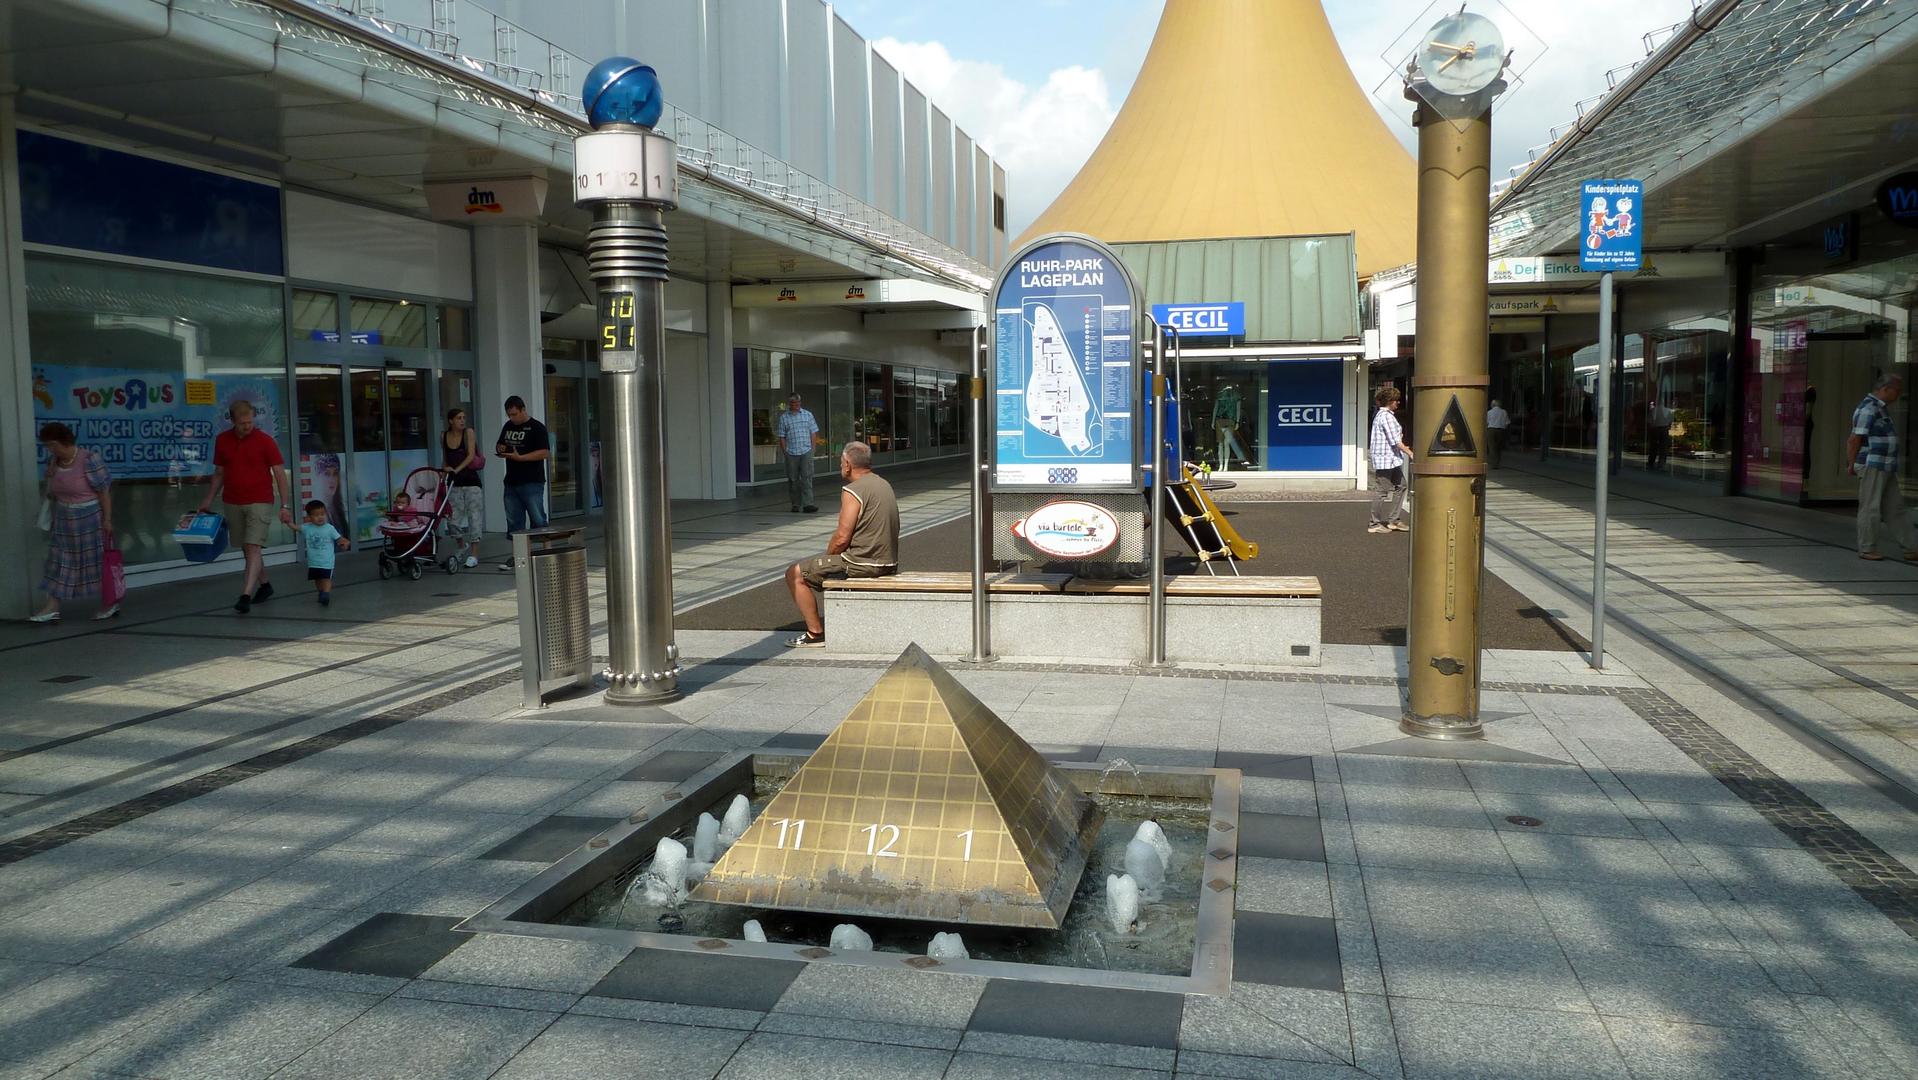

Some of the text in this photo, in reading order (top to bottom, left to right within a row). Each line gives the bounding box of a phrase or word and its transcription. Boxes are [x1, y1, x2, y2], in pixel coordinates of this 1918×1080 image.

[578, 174, 588, 188] 10
[468, 187, 495, 204] dm
[1585, 184, 1639, 195] Kinderspielplatz
[1021, 258, 1103, 273] RUHR-PARK
[1514, 263, 1537, 275] Der
[1544, 263, 1584, 274] Einka
[1021, 273, 1104, 288] LAGEPLAN
[780, 287, 795, 297] dm
[848, 285, 863, 294] dm
[611, 296, 633, 317] 10
[1168, 311, 1228, 328] CECIL
[604, 326, 634, 348] 51
[1278, 407, 1332, 422] CECIL
[88, 419, 133, 438] NOCH
[141, 416, 212, 438] GRÖSSER
[1048, 476, 1077, 484] PARK
[772, 818, 974, 862] 11 12 1
